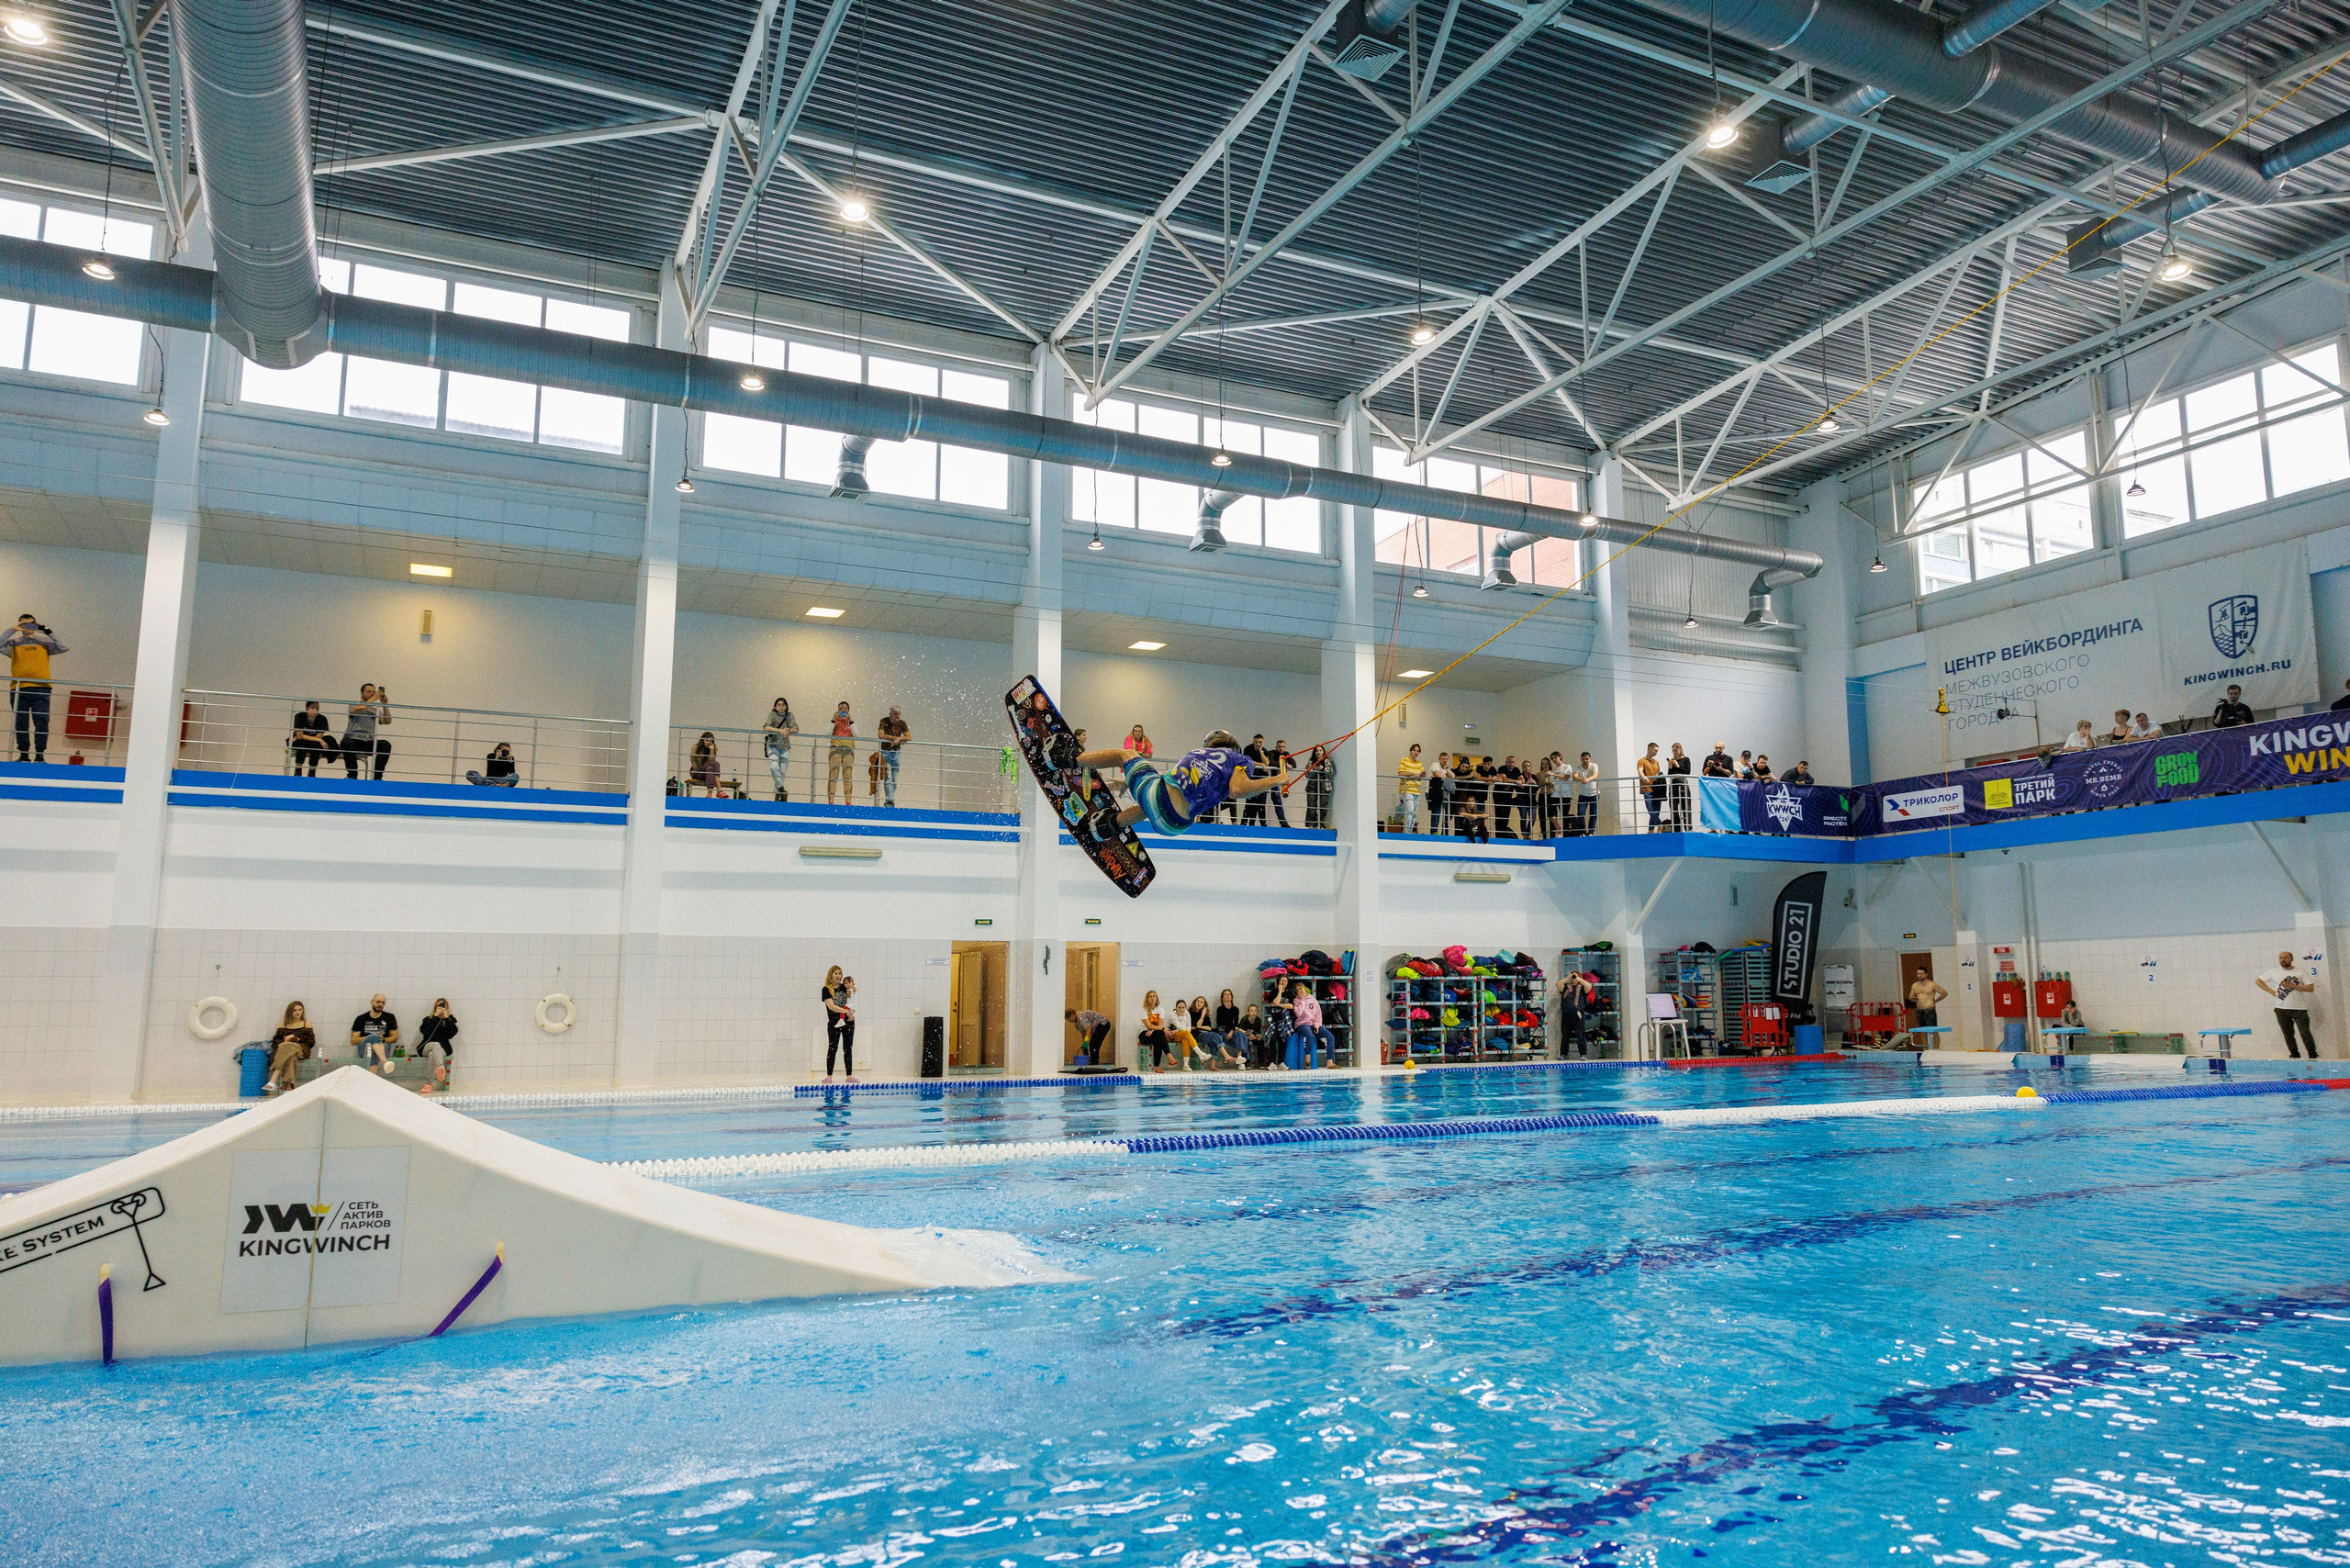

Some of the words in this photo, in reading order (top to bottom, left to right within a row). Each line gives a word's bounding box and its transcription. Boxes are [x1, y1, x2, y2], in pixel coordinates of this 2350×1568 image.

[1944, 650, 1997, 675] ЦЕНТР
[2001, 618, 2143, 662] ВЕЙКБОРДИНГА
[1945, 654, 2090, 694] МЕЖВУЗОВСКОГО
[2184, 659, 2292, 686] KINGWINCH.RU
[1947, 675, 2079, 713] СТУДЕНЧЕСКОГО
[1948, 707, 2020, 731] ГОРОДА
[2154, 751, 2199, 776] GROW
[2013, 776, 2055, 792] ТРЕТИЙ
[2085, 774, 2122, 784] MR.BEMB
[2156, 763, 2199, 789] FOOD
[1903, 792, 1959, 808] ТРИКОЛОР
[2015, 788, 2056, 804] ПАРК
[1767, 803, 1801, 816] KWWCH
[1939, 804, 1960, 812] СПОРТ
[1788, 909, 1805, 927] 21
[1784, 930, 1803, 990] STUDIO
[2311, 967, 2317, 976] 3
[348, 1201, 379, 1210] СЕТЬ
[342, 1210, 384, 1220] АКТИВ
[341, 1219, 391, 1230] ПАРКОВ
[22, 1215, 105, 1253] SYSTEM
[239, 1234, 390, 1257] KINGWINCH
